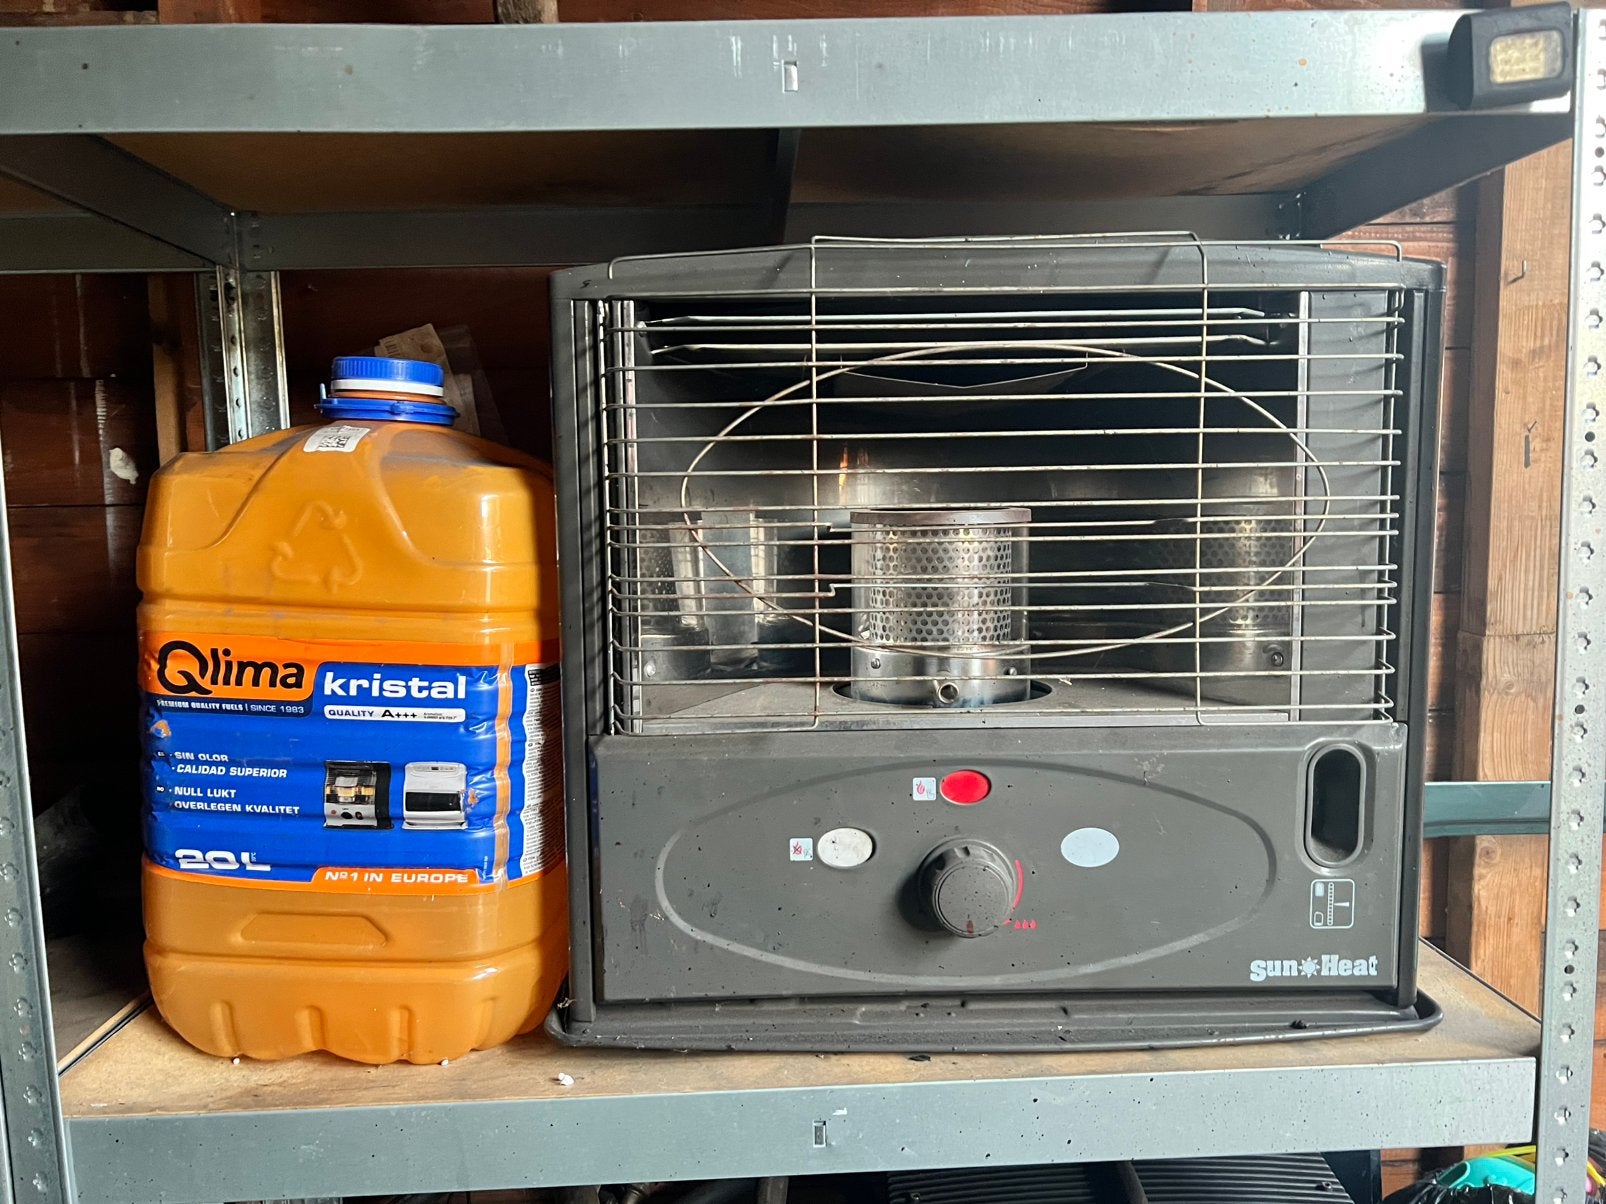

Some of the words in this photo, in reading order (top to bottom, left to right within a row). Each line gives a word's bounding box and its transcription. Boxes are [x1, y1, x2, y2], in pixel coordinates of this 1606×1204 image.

[157, 640, 305, 695] Qlima
[324, 672, 466, 699] kristal
[156, 699, 189, 708] PREMIUM
[191, 702, 220, 710] QUALITY
[222, 703, 243, 711] FUELS
[250, 704, 277, 713] SINCE
[279, 705, 304, 714] 1983
[328, 709, 374, 717] QUALITY
[381, 709, 418, 718] A+++
[174, 751, 194, 760] SIN
[198, 753, 229, 762] OLOR
[176, 764, 226, 775] CALIDAD
[229, 766, 288, 778] SUPERIOR
[174, 786, 204, 796] NULL
[207, 788, 237, 798] LUKT
[174, 801, 242, 812] OVERLEGEN
[245, 804, 300, 814] KVALITET
[364, 872, 384, 882] IN
[391, 873, 469, 883] EUROPE
[1320, 954, 1378, 976] Heat
